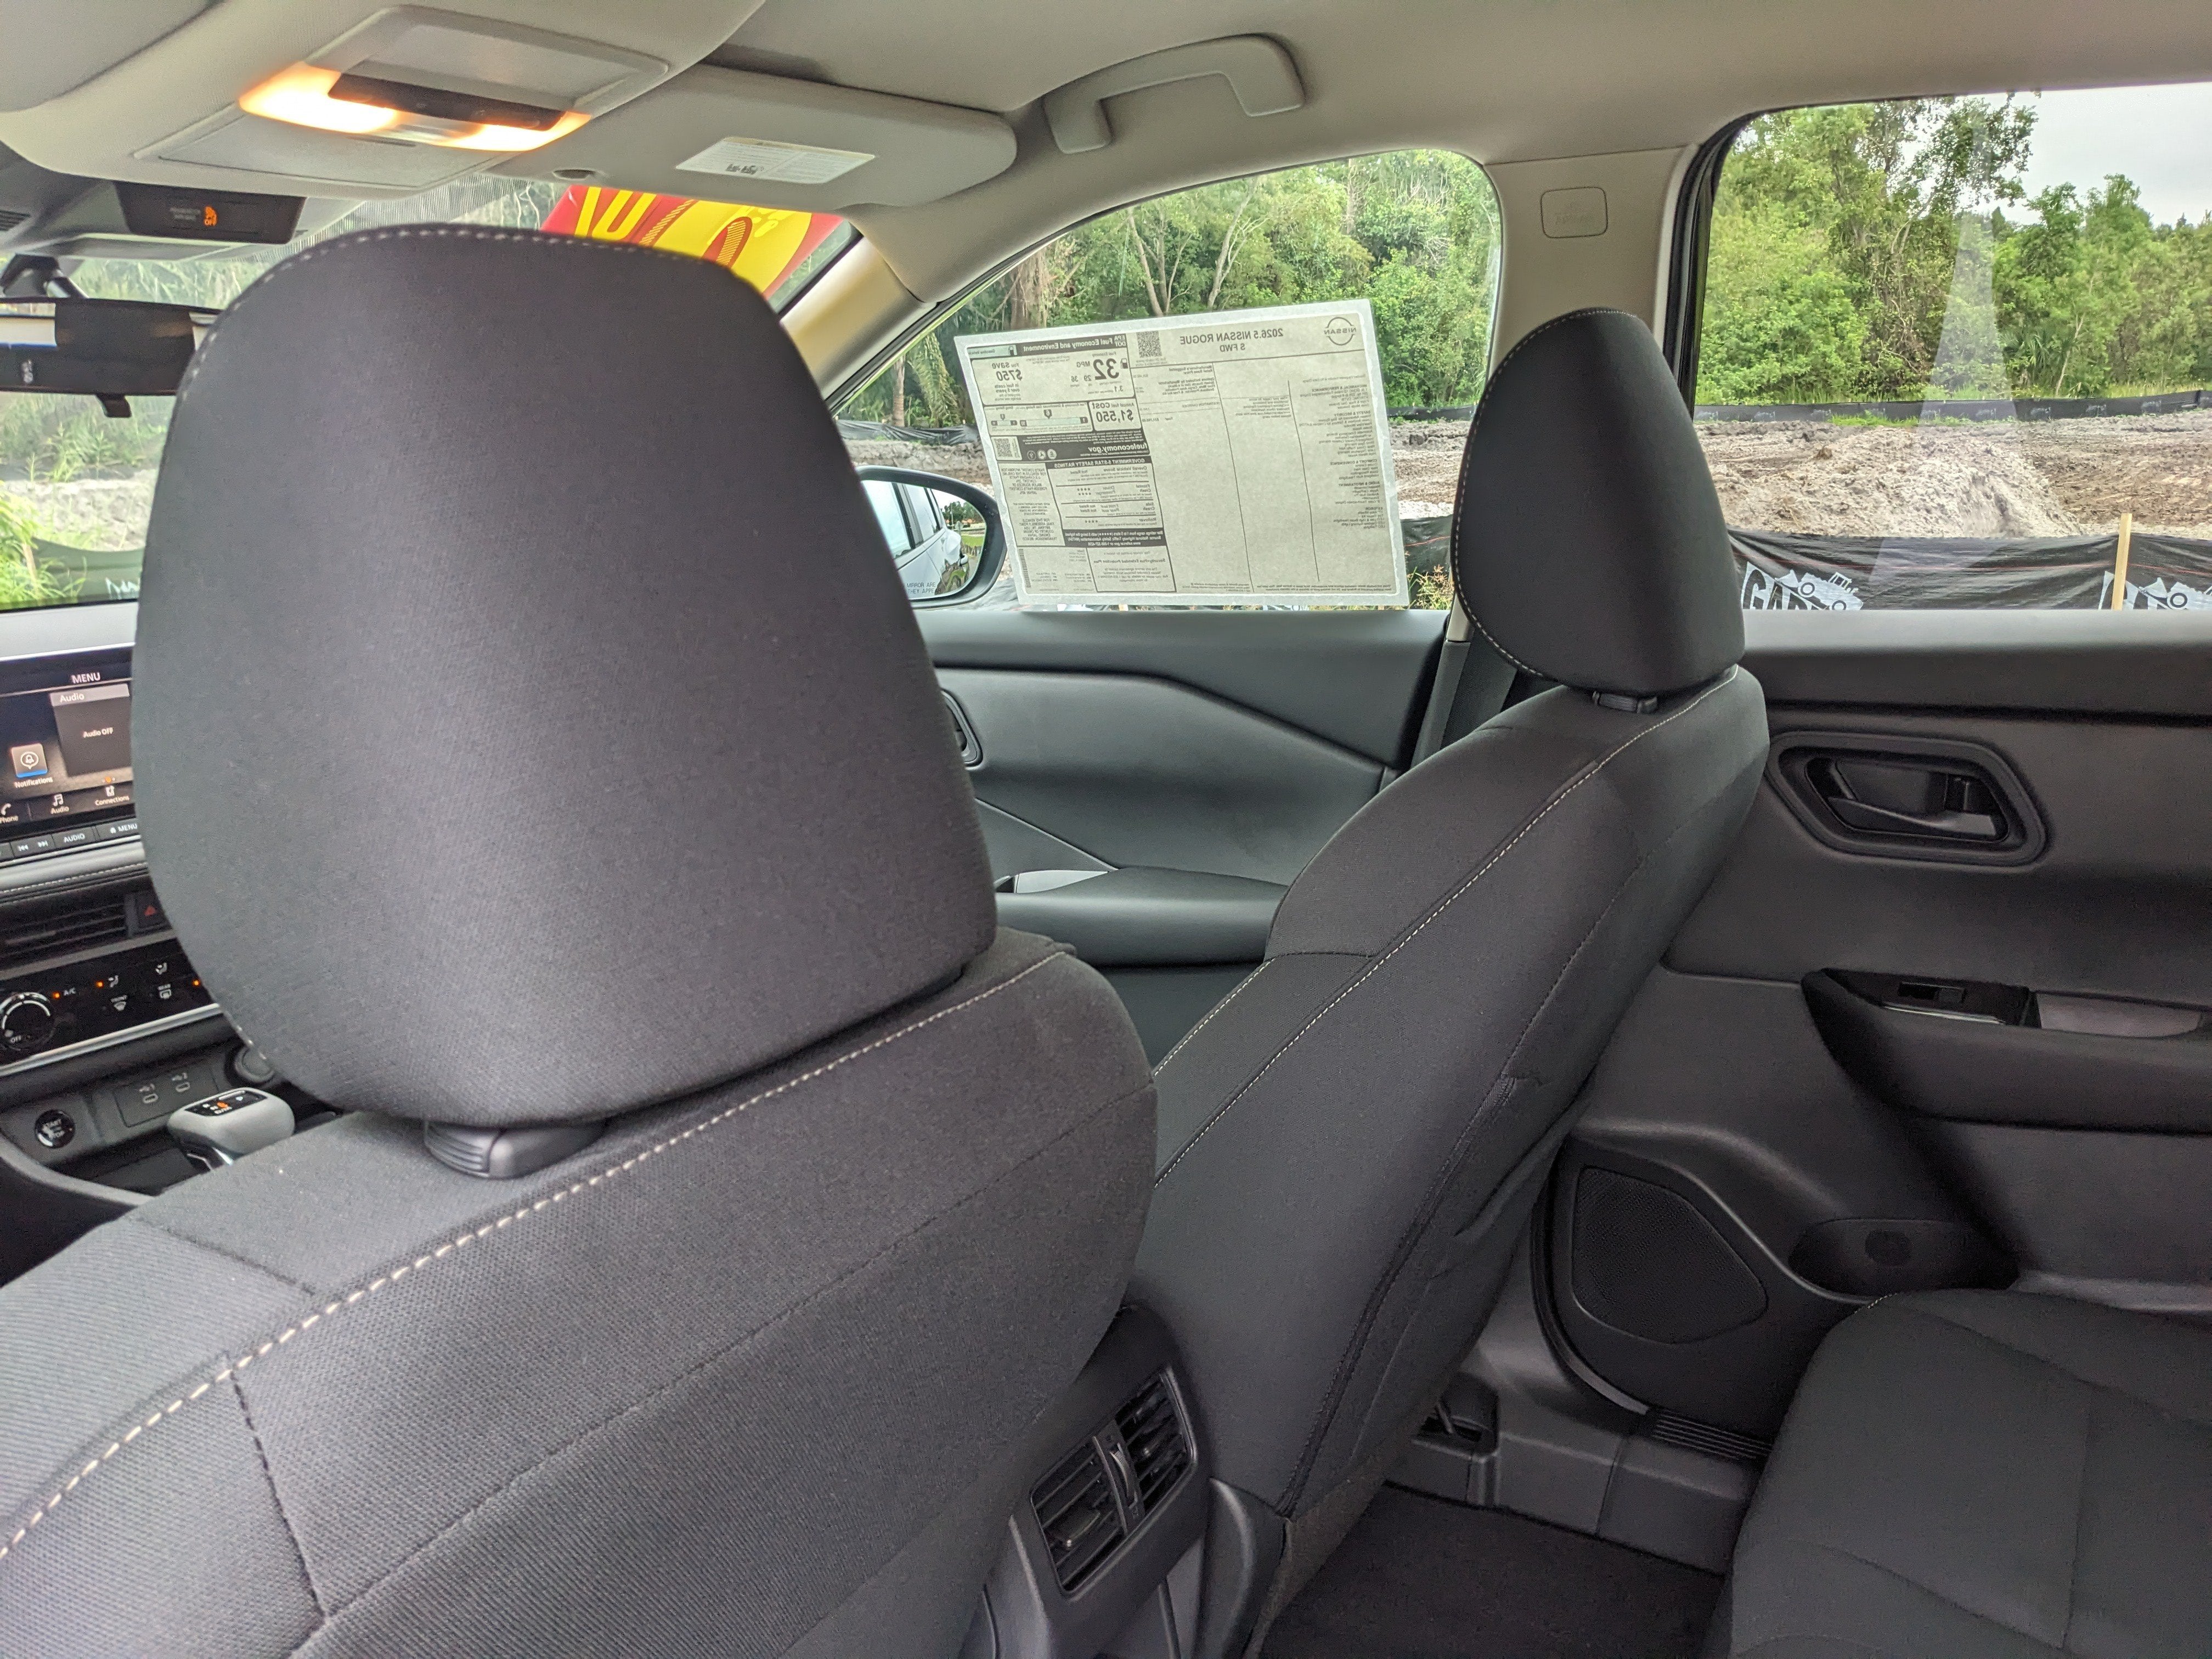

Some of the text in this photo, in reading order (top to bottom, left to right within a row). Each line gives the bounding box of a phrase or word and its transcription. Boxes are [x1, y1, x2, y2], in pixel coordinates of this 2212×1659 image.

[70, 672, 101, 684] MENU
[59, 692, 84, 702] Audio
[83, 730, 101, 738] Audio
[13, 777, 54, 788] Notifications
[94, 795, 130, 806] Connections
[50, 805, 70, 815] Audio
[117, 823, 138, 833] MENU
[63, 833, 86, 843] AUDIO
